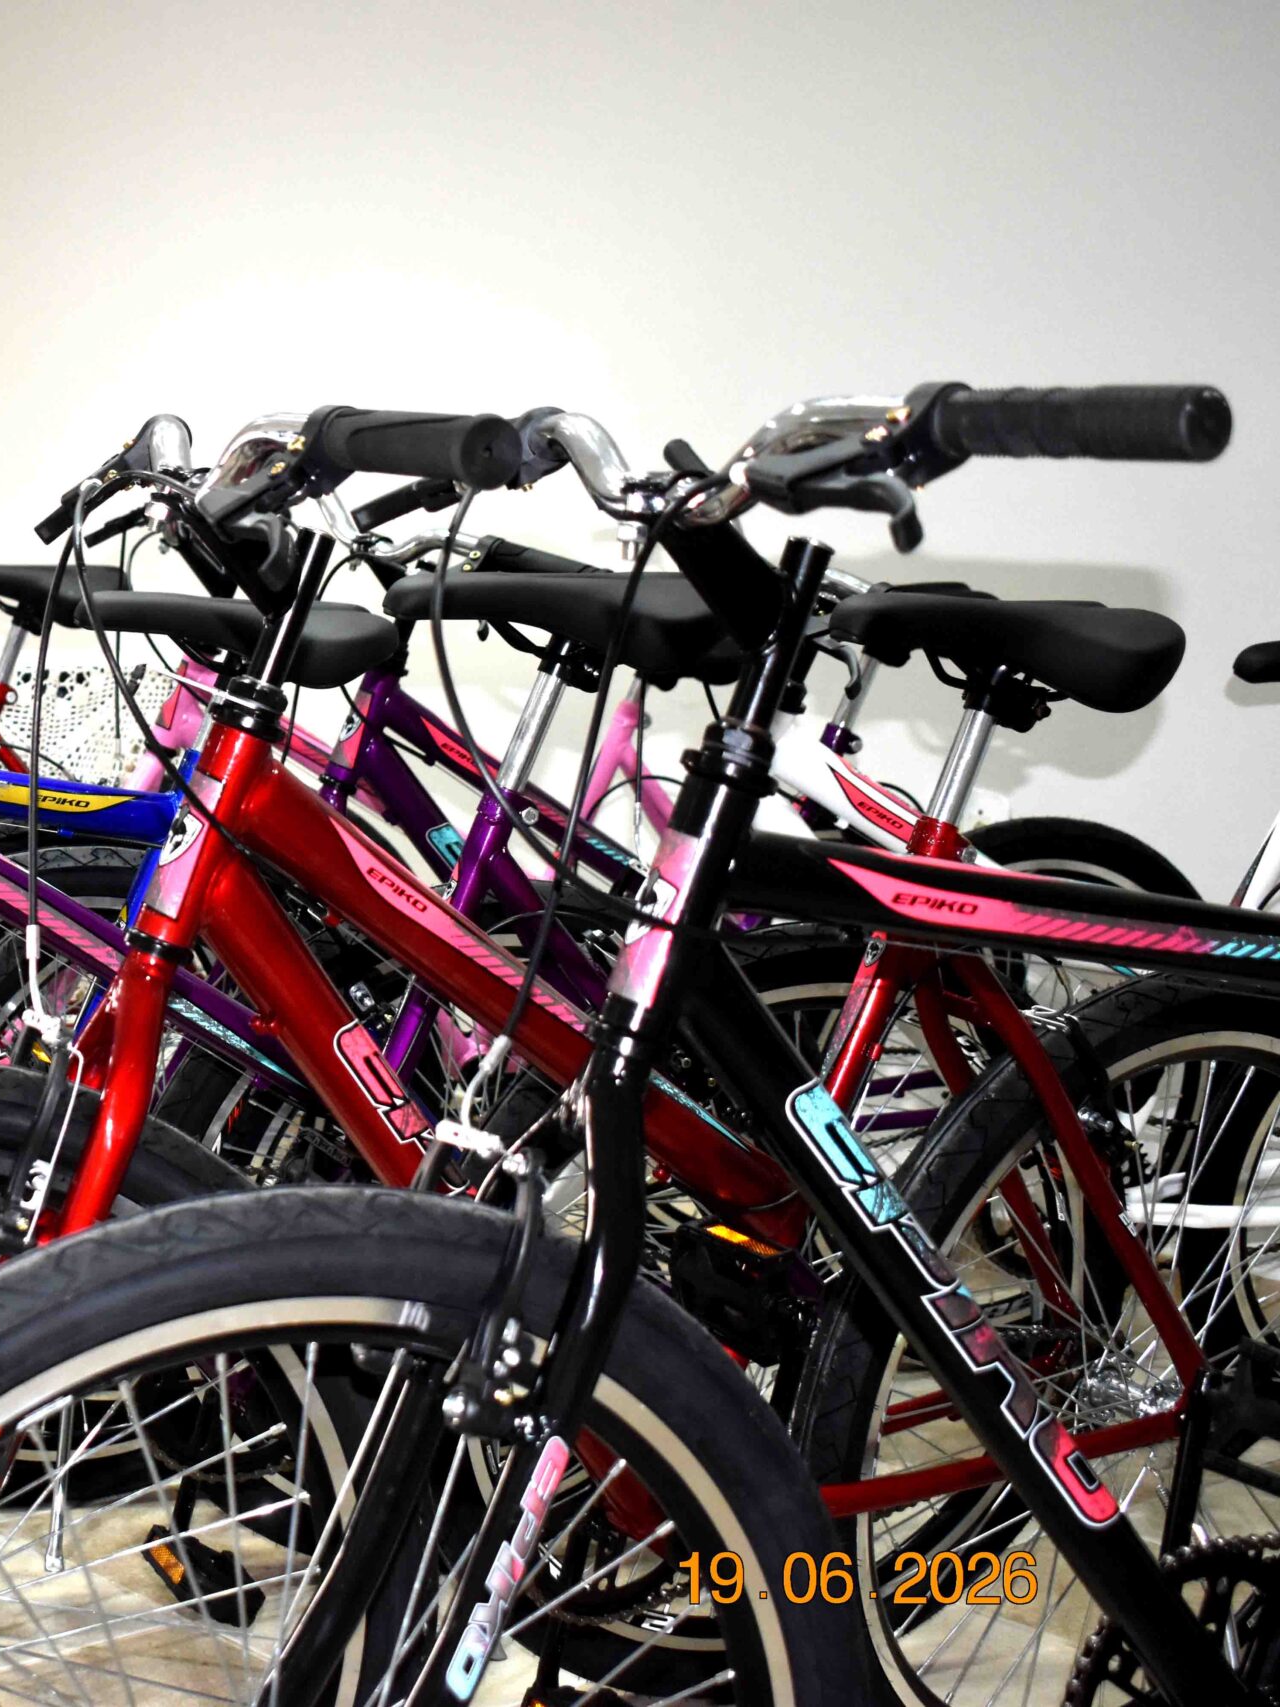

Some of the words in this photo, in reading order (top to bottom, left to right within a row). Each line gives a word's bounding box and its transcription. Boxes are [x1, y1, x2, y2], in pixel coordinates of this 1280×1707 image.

[857, 800, 904, 830] EPIKO
[366, 867, 428, 913] EPIKO
[892, 892, 979, 916] EPIKO
